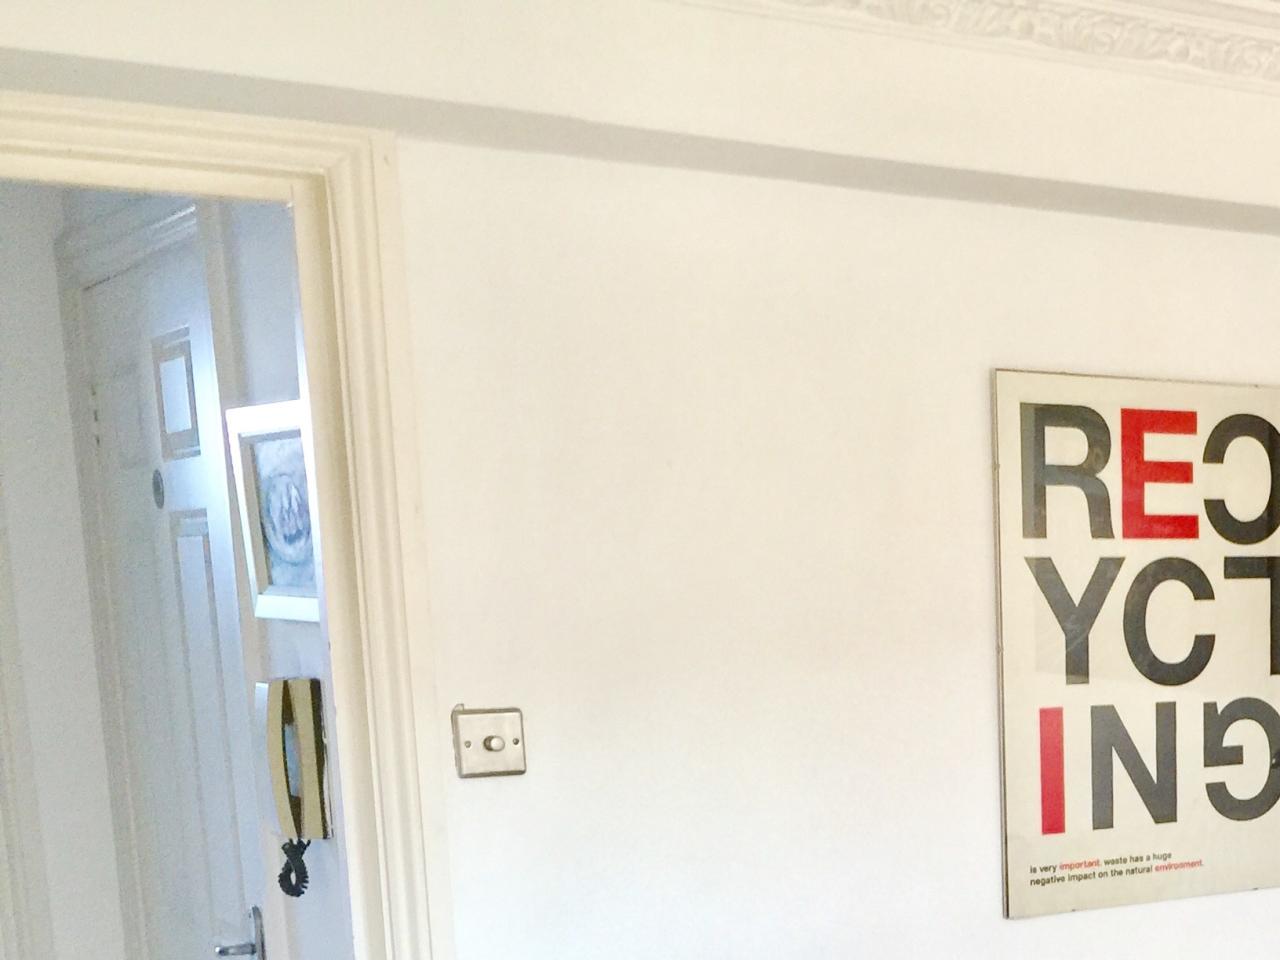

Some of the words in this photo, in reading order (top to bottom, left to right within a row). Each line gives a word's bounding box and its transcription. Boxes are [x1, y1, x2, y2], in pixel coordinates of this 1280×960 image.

[1030, 865, 1037, 874] is
[1039, 864, 1058, 873] very
[1103, 856, 1128, 866] waste
[1129, 855, 1144, 863] has
[1152, 852, 1172, 862] huge
[1030, 874, 1066, 887] negative
[1067, 871, 1096, 882] impact
[1098, 870, 1109, 879] on
[1110, 868, 1124, 877] the
[1125, 864, 1153, 876] natural
